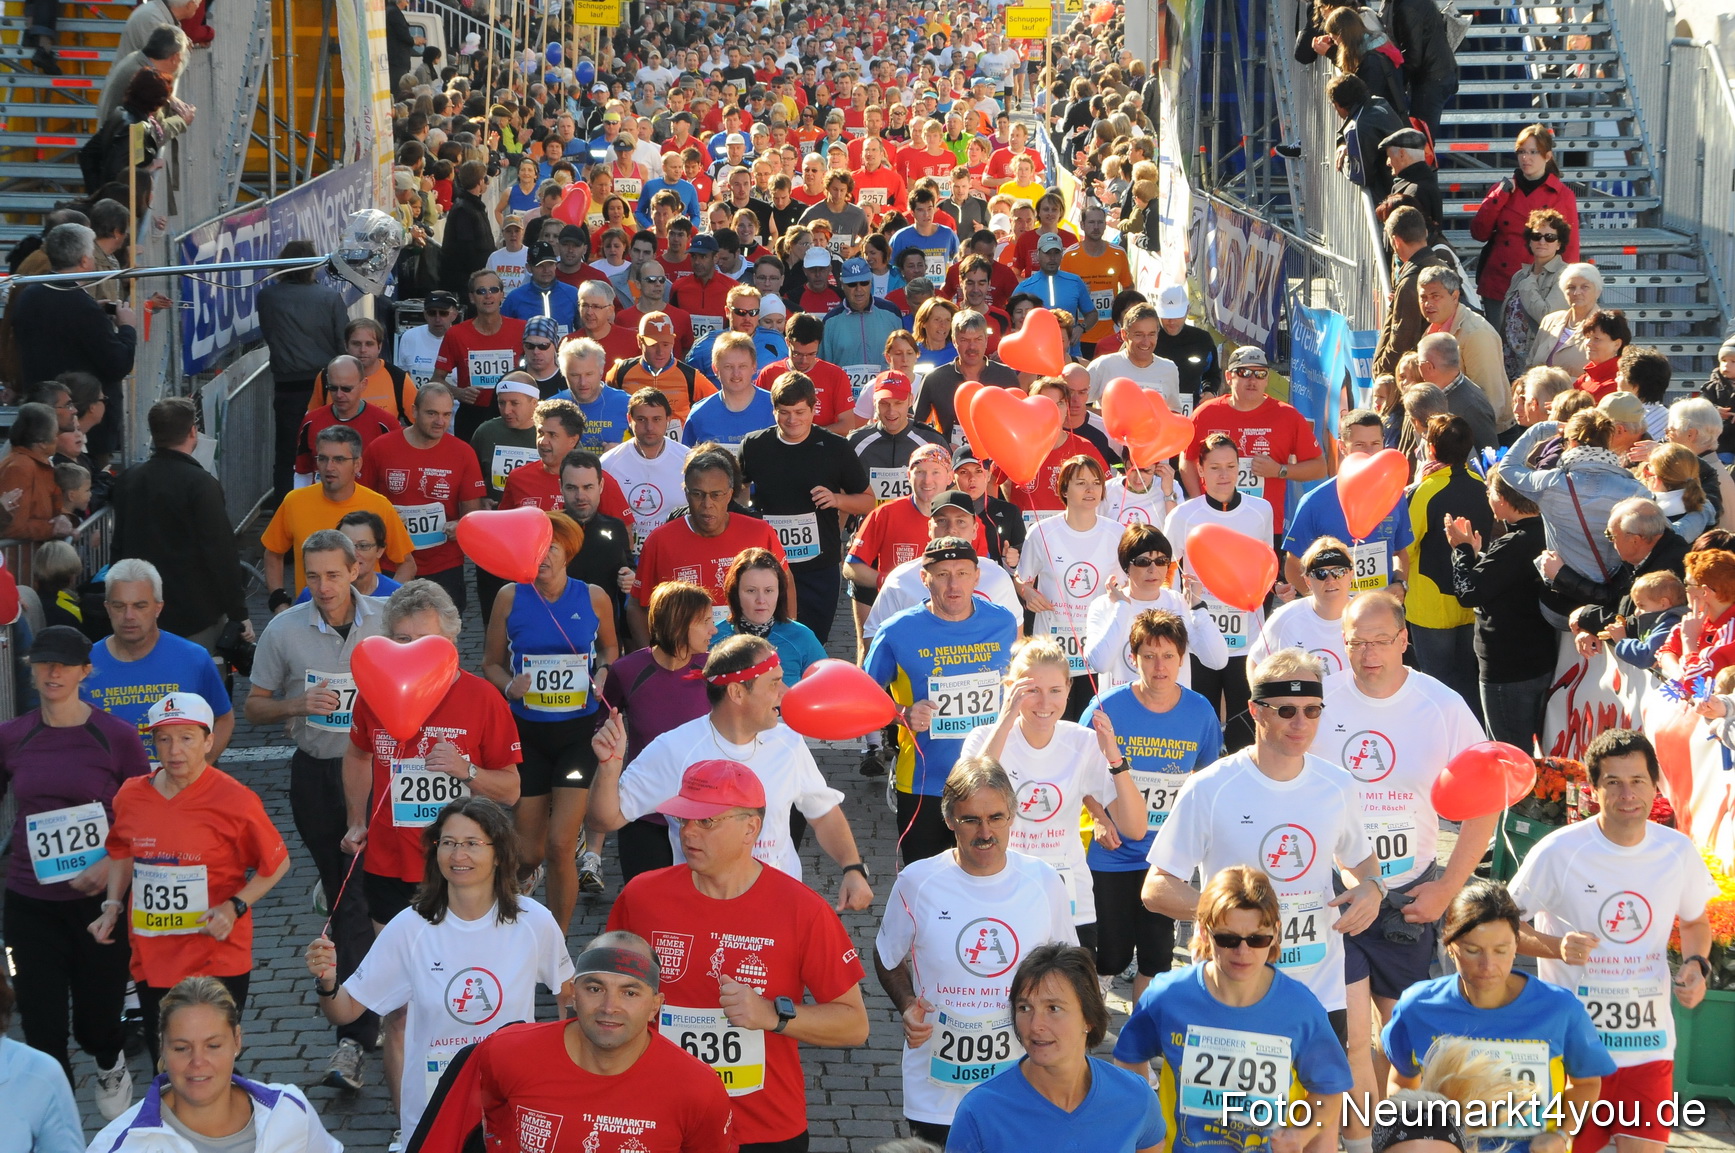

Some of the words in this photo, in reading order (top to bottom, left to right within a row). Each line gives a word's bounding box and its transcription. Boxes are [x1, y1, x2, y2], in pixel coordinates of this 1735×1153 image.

[578, 2, 617, 11] Schnupper-
[620, 184, 637, 193] 330
[925, 264, 942, 275] 46
[1095, 297, 1110, 310] 50
[473, 359, 509, 375] 3019
[479, 376, 500, 384] Rudo
[1182, 403, 1189, 417] 6
[961, 436, 969, 446] 8
[503, 458, 534, 475] 56
[1238, 470, 1258, 487] 25
[406, 515, 439, 534] 507
[1356, 557, 1377, 577] 33
[918, 648, 933, 658] 10.
[935, 642, 1001, 656] NEUMARKTER
[933, 652, 992, 666] STADTLAUF
[536, 670, 574, 691] 692
[940, 680, 971, 689] PFLEIDERER
[90, 689, 104, 698] 10.
[105, 683, 180, 697] NEUMARKTER
[540, 693, 571, 704] Luise
[938, 689, 994, 716] 2132
[326, 713, 352, 725] Bod
[425, 727, 467, 735] NEUMARKTER
[376, 747, 394, 755] NEU
[1128, 736, 1198, 752] NEUMARKTER
[1125, 746, 1185, 760] STADTLAUF
[400, 776, 462, 802] 2868
[1388, 791, 1414, 800] HERZ
[36, 822, 101, 858] 3128
[1029, 832, 1043, 840] MIT
[1047, 829, 1065, 838] HERZ
[1376, 833, 1408, 859] 00
[56, 856, 87, 872] Ines
[1381, 863, 1391, 875] rt
[143, 883, 188, 910] 635
[146, 913, 184, 927] Carla
[1284, 914, 1317, 944] 44
[656, 938, 685, 948] IMMER
[710, 932, 721, 940] 11.
[722, 933, 775, 947] NEUMARKTER
[719, 940, 763, 951] STADTLAUF
[655, 946, 685, 957] WIEDER
[1279, 950, 1301, 964] udi
[1587, 956, 1621, 964] AUFEN
[1623, 956, 1642, 964] MIT
[660, 967, 681, 976] ARKT
[1599, 967, 1618, 975] Heck
[936, 983, 976, 996] LAUFEN
[980, 988, 1001, 996] MIT
[1004, 986, 1011, 997] H
[1590, 986, 1630, 996] PFLEIDERER
[945, 999, 955, 1007] Dr.
[956, 1001, 976, 1009] Heck
[983, 1001, 995, 1009] Dr.
[673, 1015, 716, 1025] PFLEIDERER
[1587, 1000, 1657, 1030] 2394
[947, 1016, 983, 1029] PFLEIDERER
[430, 1036, 468, 1048] LAUFEN
[472, 1035, 488, 1044] MI
[939, 1031, 1011, 1062] 2093
[1171, 1032, 1185, 1047] 10.
[1201, 1035, 1246, 1049] PFLEIDERER
[680, 1031, 742, 1064] 636
[439, 1060, 450, 1068] PFL
[952, 1064, 996, 1081] Josef
[1193, 1052, 1277, 1094] 2793
[521, 1113, 553, 1129] IMMER
[582, 1113, 595, 1122] 11.
[596, 1115, 656, 1129] NEUMARKTER
[520, 1121, 552, 1138] WIEDER
[593, 1123, 644, 1135] STADTLAUF
[520, 1131, 548, 1148] NEU
